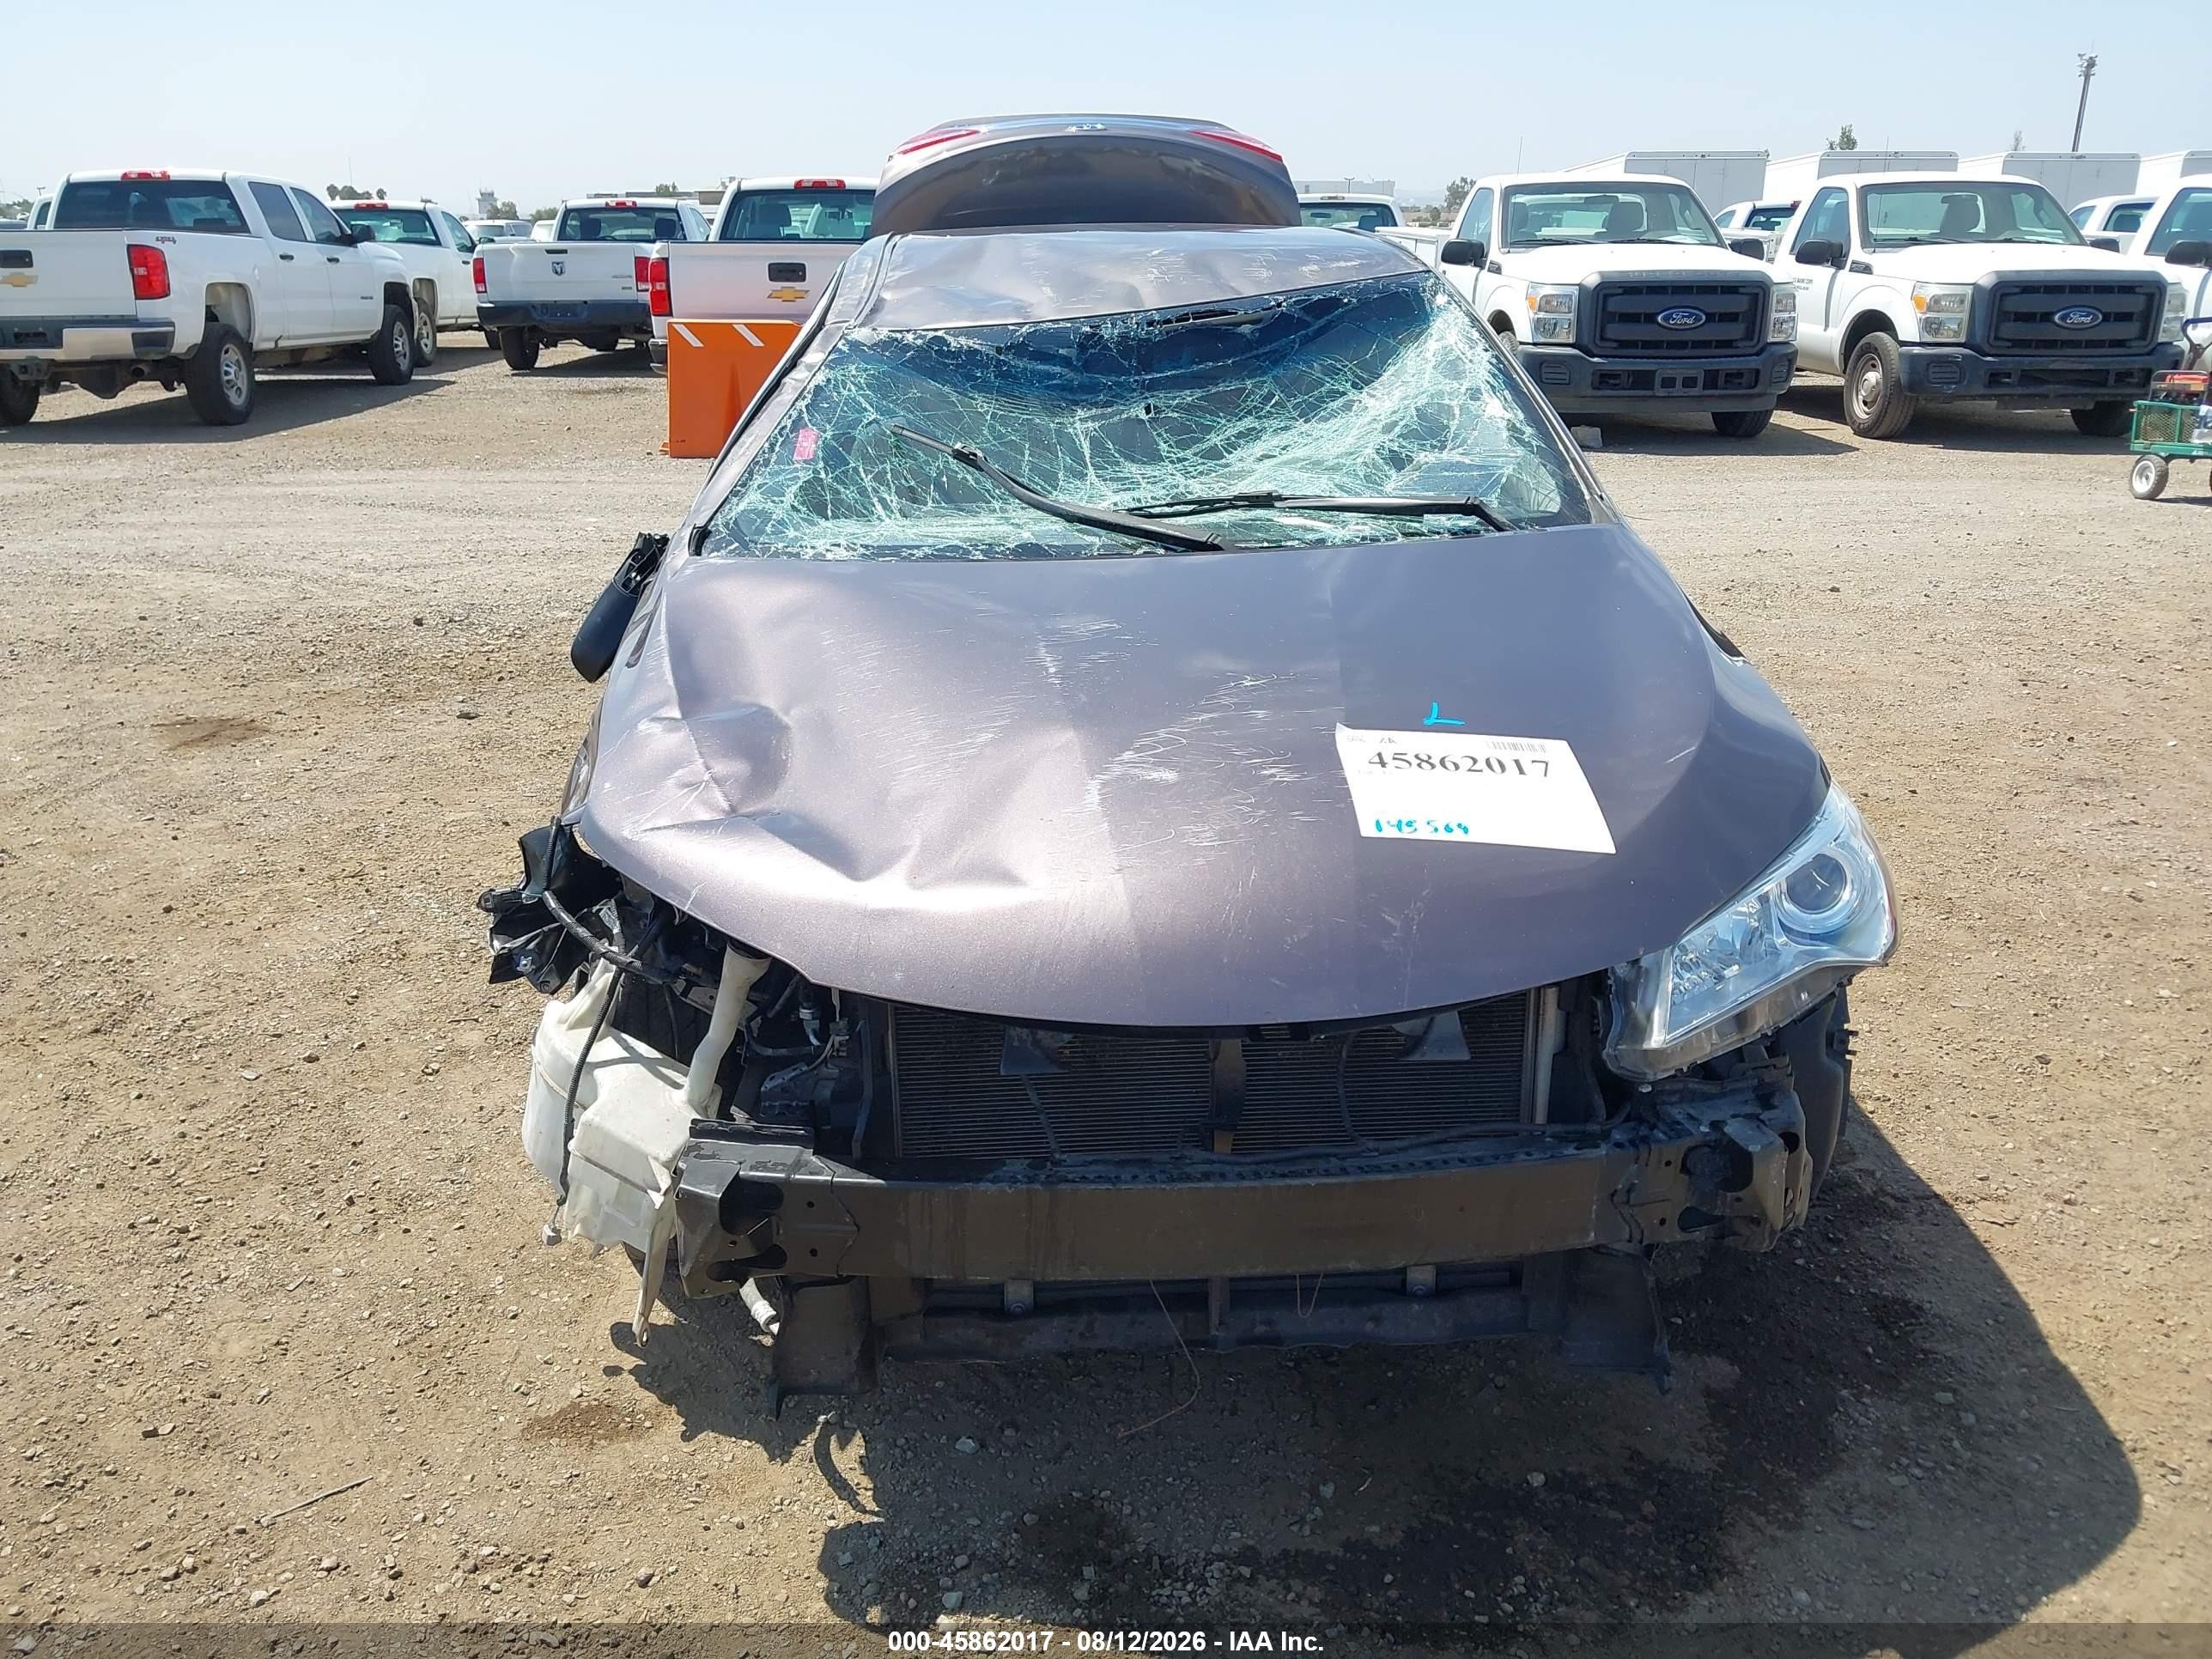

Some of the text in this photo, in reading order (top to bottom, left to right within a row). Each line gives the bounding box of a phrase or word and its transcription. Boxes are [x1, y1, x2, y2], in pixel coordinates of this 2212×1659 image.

[1669, 312, 1695, 325] Ford
[2066, 311, 2094, 324] Ford
[1368, 751, 1550, 777] 45862017
